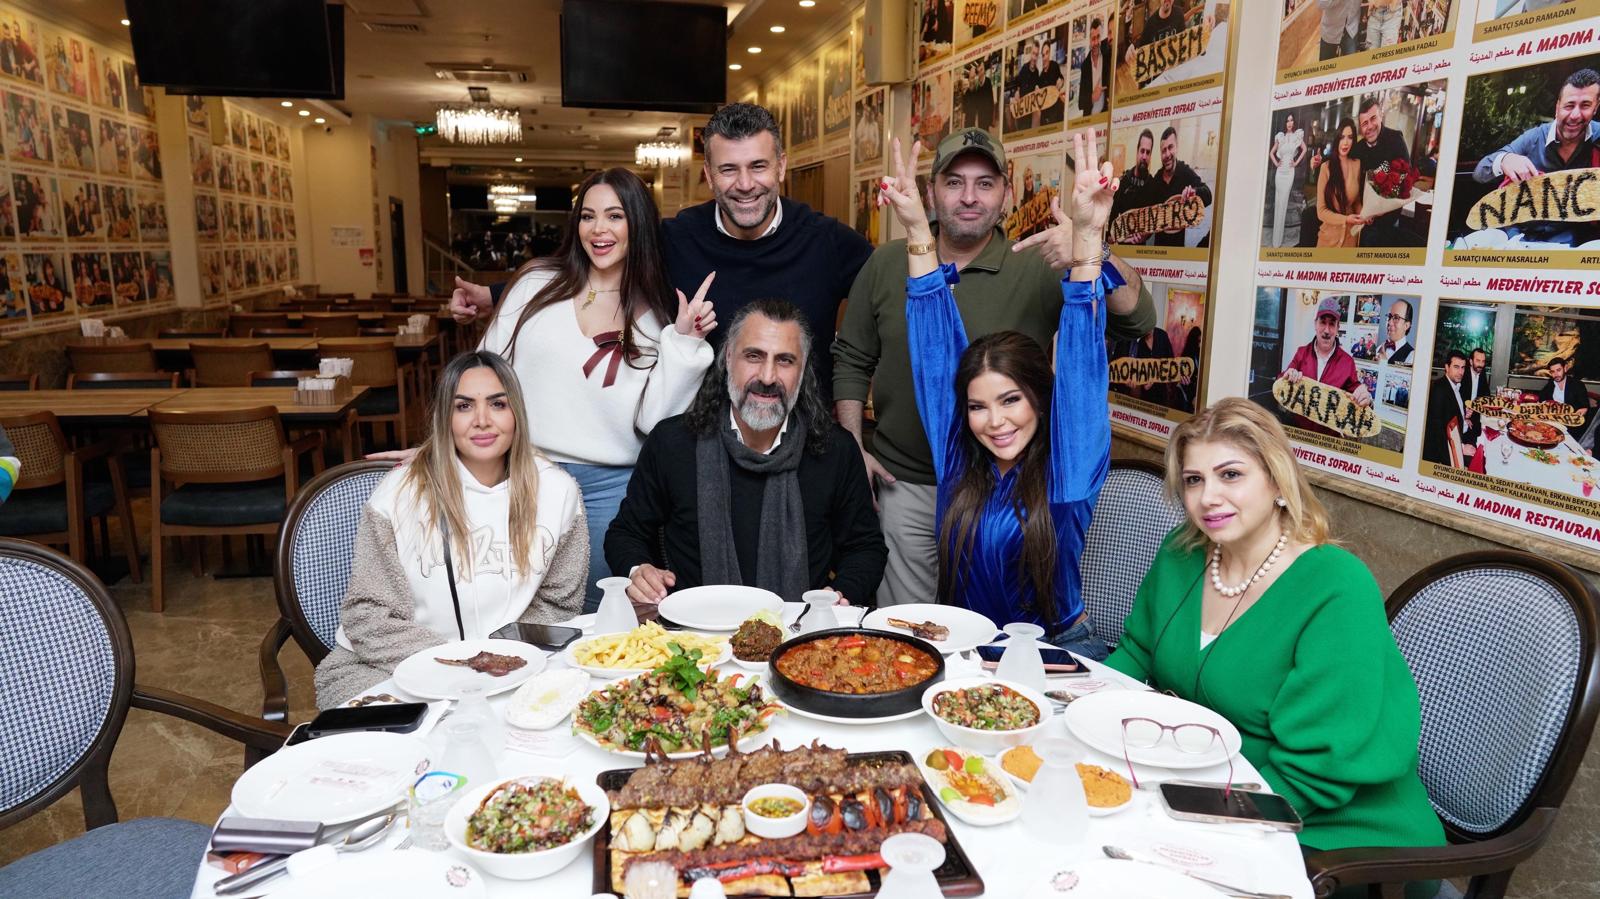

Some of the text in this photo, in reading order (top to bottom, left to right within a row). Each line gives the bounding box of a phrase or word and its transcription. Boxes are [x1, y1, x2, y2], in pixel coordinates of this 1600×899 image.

[1484, 7, 1576, 34] SANATÇI SAAD RAMADAN
[1372, 40, 1438, 60] ACTRESS MENNA FADALI
[1516, 28, 1594, 56] AL MADINA
[1135, 26, 1203, 81] BASSEM
[1305, 67, 1408, 96] MEDENİYETLER SOFRASI
[1172, 102, 1196, 114] SOFRASI
[1480, 172, 1598, 230] NANC
[1454, 255, 1481, 264] SANATÇI
[1149, 267, 1184, 278] RESTAURANT
[1284, 270, 1386, 285] AL MADINA RESTAURANT
[1486, 276, 1583, 295] MEDENİYETLER
[1109, 361, 1178, 382] MOHAMED
[1148, 421, 1170, 434] SOFRASI
[1328, 457, 1362, 475] SOFRASI
[1433, 471, 1450, 480] ACTOR
[1451, 475, 1465, 484] OZAN
[1466, 478, 1489, 490] AKBABA,
[1490, 485, 1508, 495] SEDAT
[1509, 489, 1542, 503] KALKAVAN,
[1544, 498, 1564, 508] ERKAN
[1565, 504, 1589, 515] BEKTAŞ
[1434, 464, 1597, 509] OYUNCU OZAN AKBABA, SEDAT KALKAVAN, ERKAN BEKTAŞ
[1456, 492, 1600, 542] AL MADINA RESTAURAN
